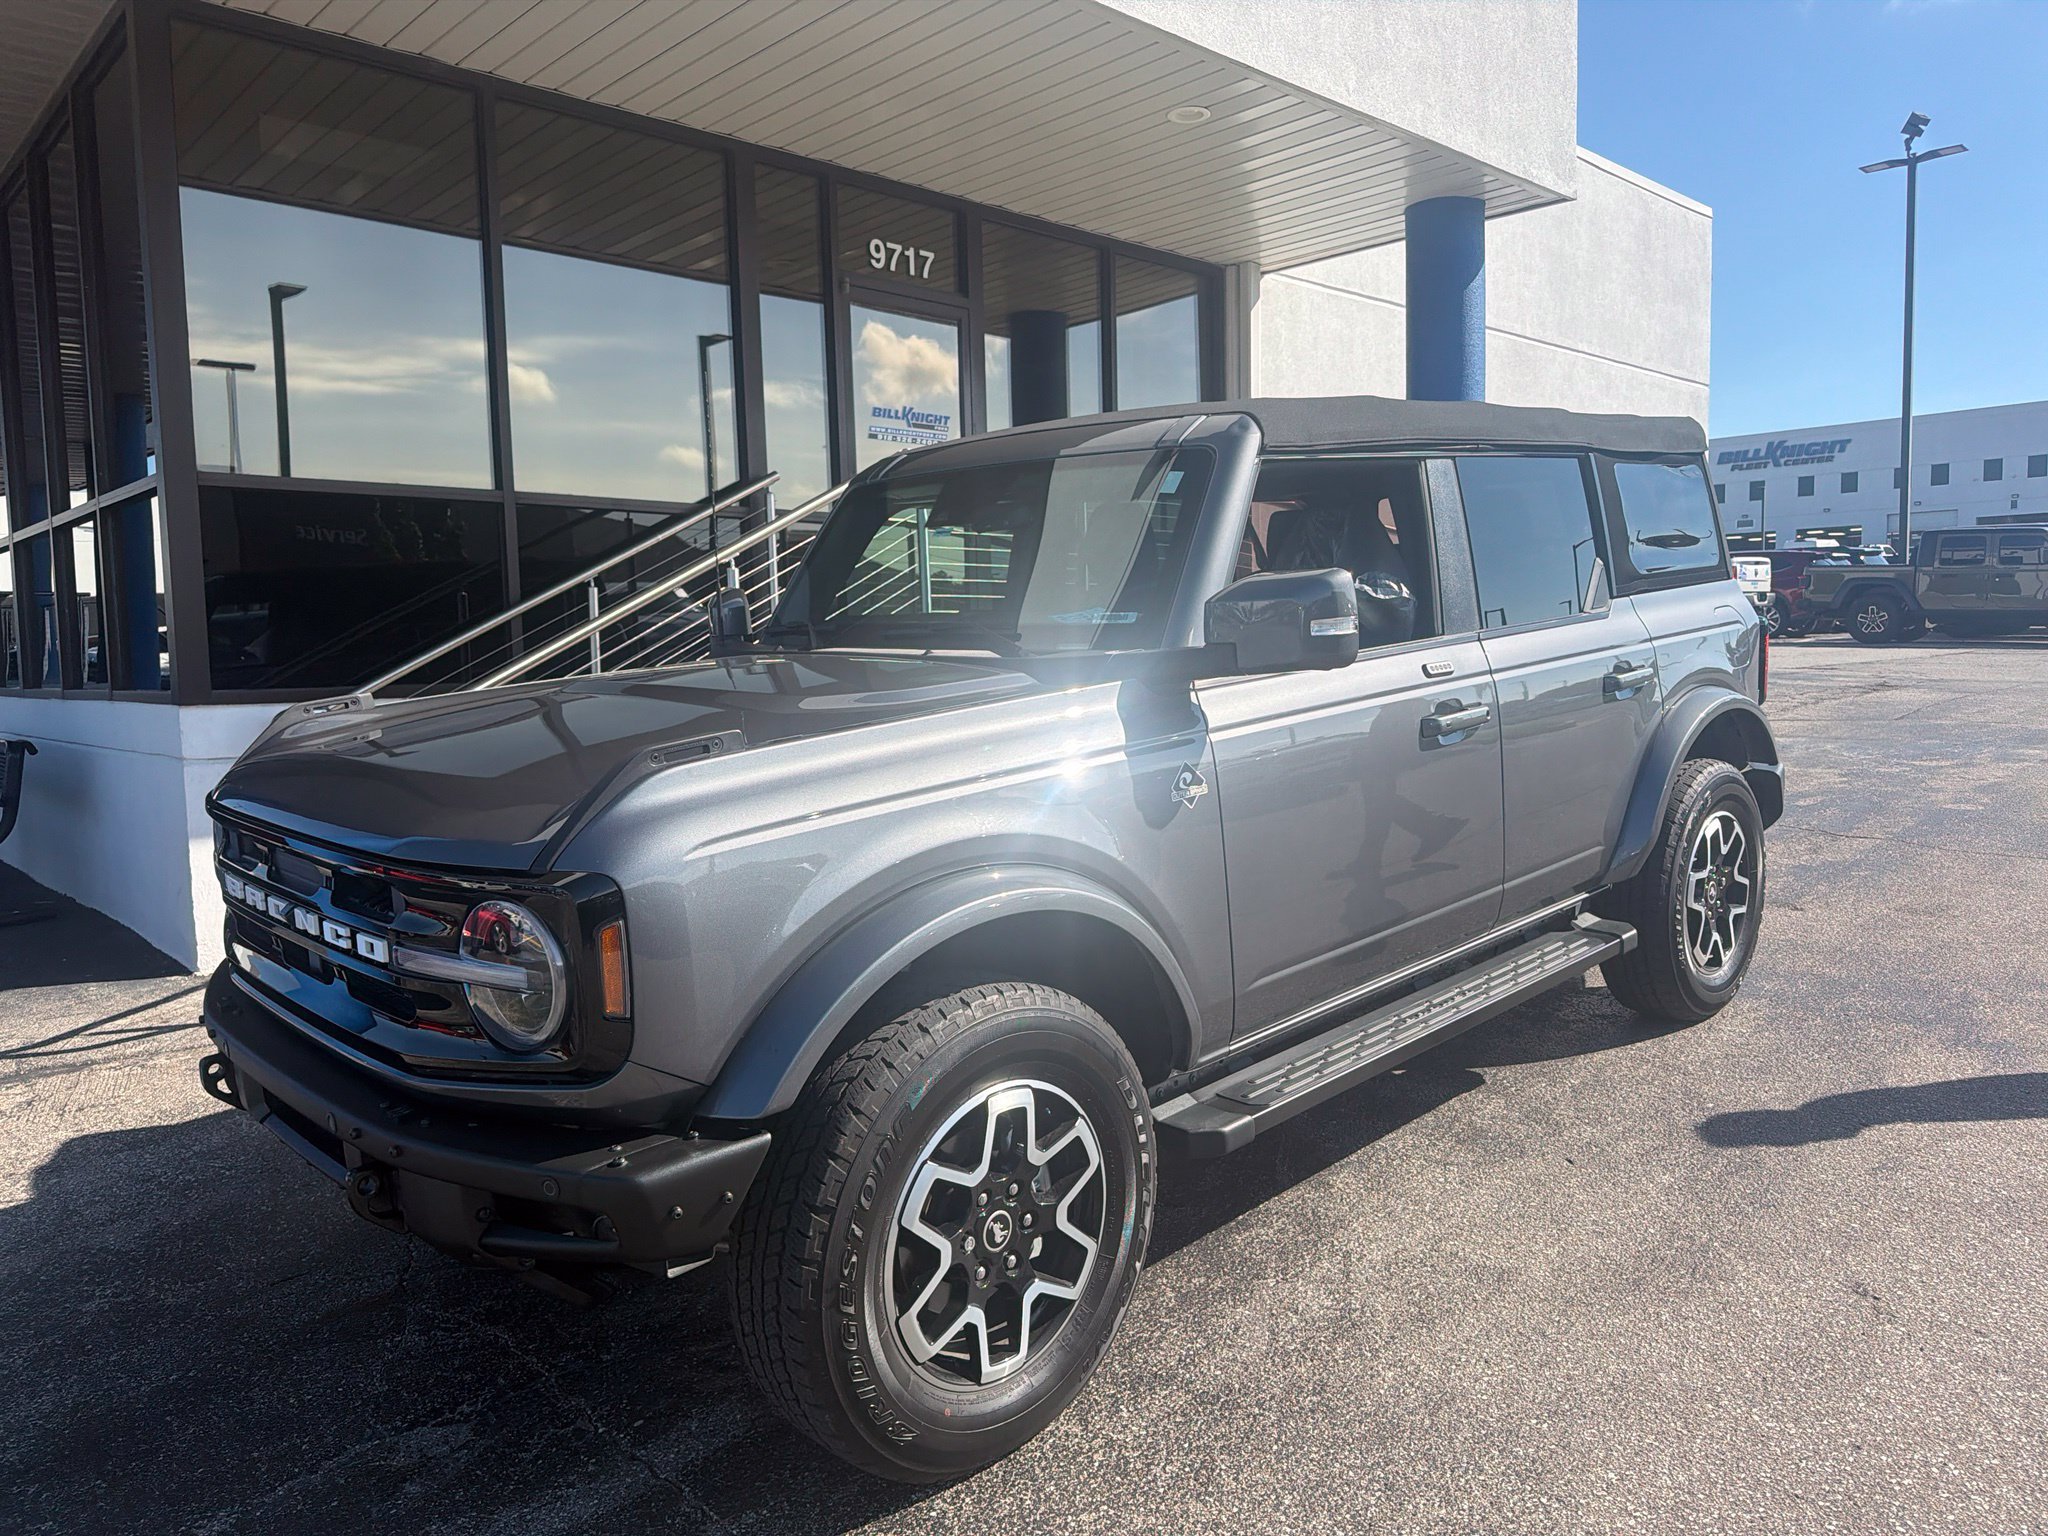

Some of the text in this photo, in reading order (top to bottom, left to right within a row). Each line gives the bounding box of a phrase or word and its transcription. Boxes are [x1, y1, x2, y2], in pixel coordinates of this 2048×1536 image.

[869, 238, 934, 279] 9717
[1730, 455, 1835, 471] FLEET CENTER
[225, 872, 390, 963] BRONCO
